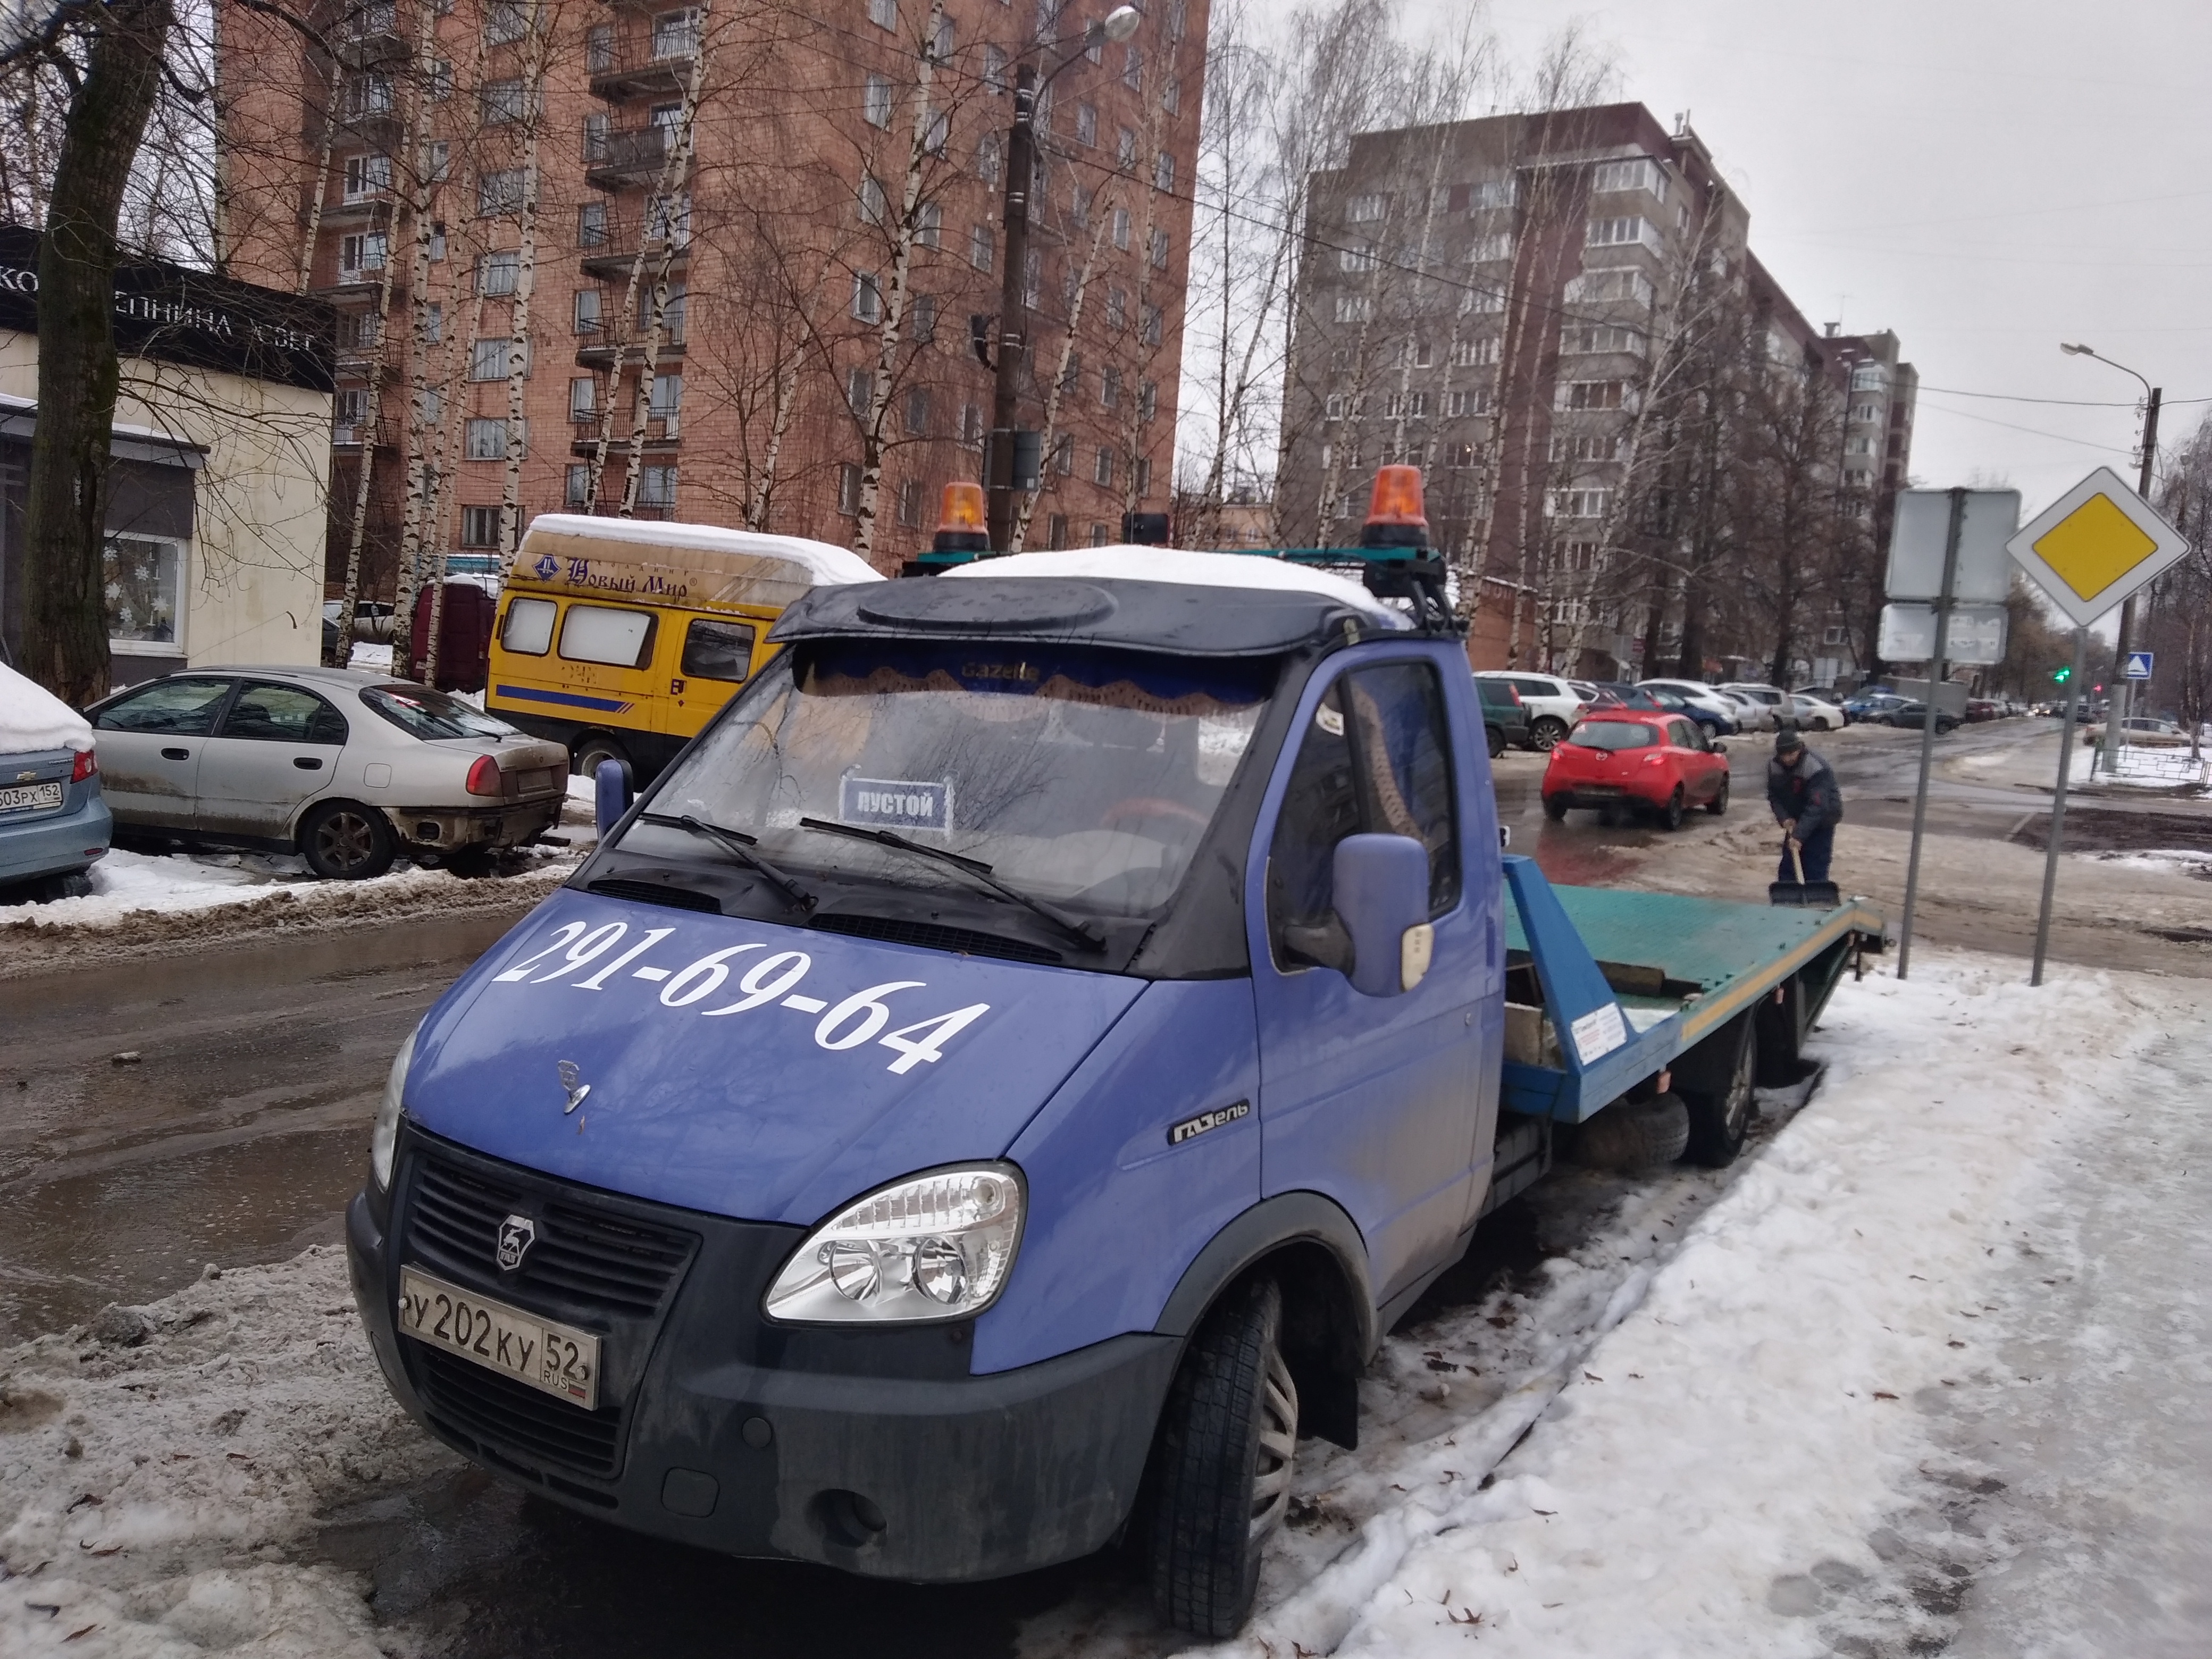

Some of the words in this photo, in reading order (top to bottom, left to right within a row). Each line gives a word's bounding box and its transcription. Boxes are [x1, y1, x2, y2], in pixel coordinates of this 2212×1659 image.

[565, 557, 636, 592] Новый
[642, 575, 688, 601] Мир
[39, 785, 58, 797] 152
[857, 791, 933, 817] ПУСТОЙ
[492, 920, 991, 1075] 291-69-64
[1173, 1104, 1249, 1143] ГАЗель
[546, 1334, 579, 1380] 52
[543, 1370, 568, 1390] RUS
